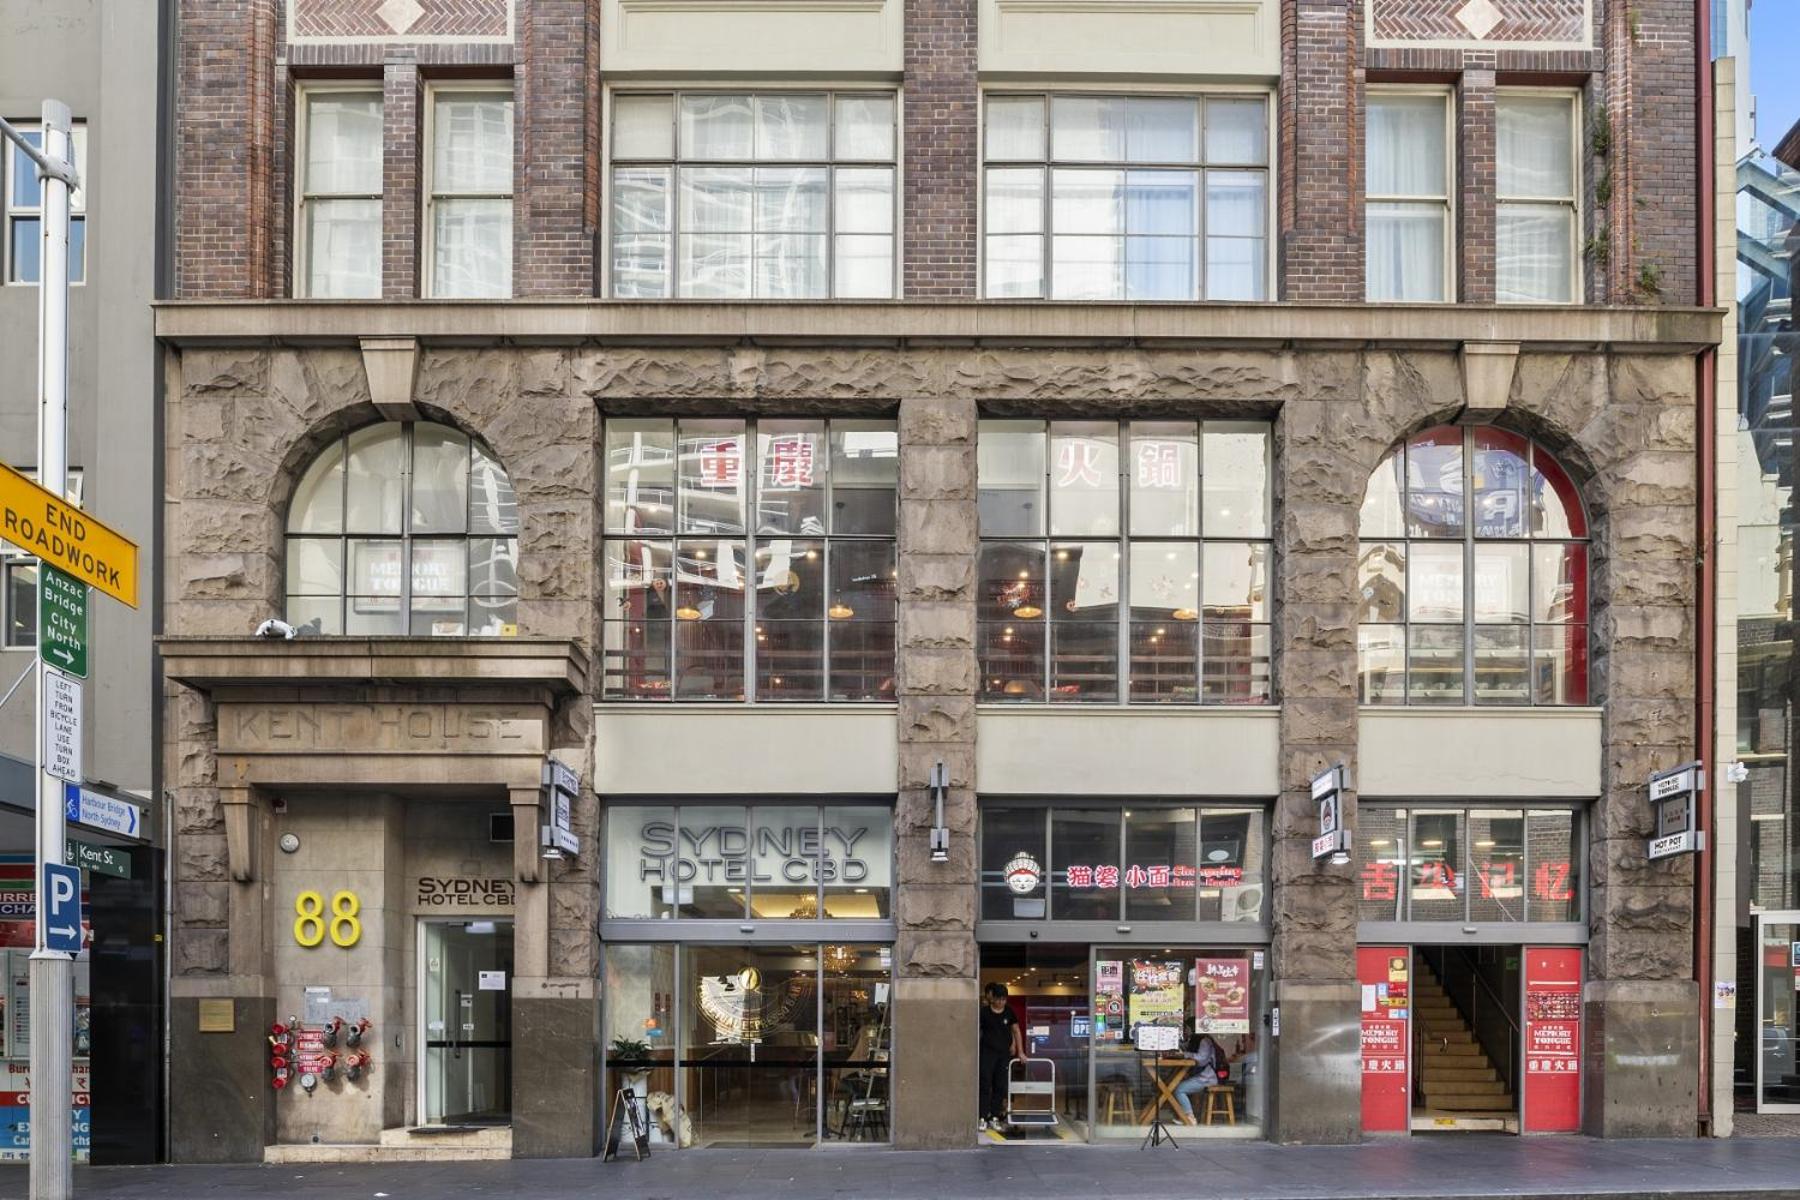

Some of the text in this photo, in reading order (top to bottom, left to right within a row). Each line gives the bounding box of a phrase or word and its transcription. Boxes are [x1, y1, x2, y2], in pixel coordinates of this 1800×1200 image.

[1058, 440, 1181, 488] 火鍋
[46, 503, 86, 542] END
[5, 507, 121, 590] ROADWORK
[46, 571, 83, 599] Anzac
[45, 587, 83, 616] Bridge
[51, 612, 77, 635] City
[47, 625, 81, 651] North
[56, 680, 71, 692] LEFT
[56, 690, 72, 703] TURN
[50, 710, 77, 726] BICYCLE
[55, 701, 72, 714] FROM
[55, 723, 72, 735] LANE
[236, 707, 522, 742] KENT HOUSE
[55, 743, 72, 756] TURN
[57, 733, 70, 745] USE
[57, 754, 69, 765] BOX
[53, 764, 75, 777] AHEAD
[82, 808, 121, 830] North Sydney
[641, 821, 868, 857] SYDNEY
[1655, 836, 1682, 849] HOT POT
[80, 844, 114, 865] Kent St
[640, 857, 868, 882] HOTEL CBD
[51, 873, 74, 915] P
[418, 877, 516, 894] SYDNEY
[418, 893, 479, 906] HOTEL
[294, 889, 362, 947] 88
